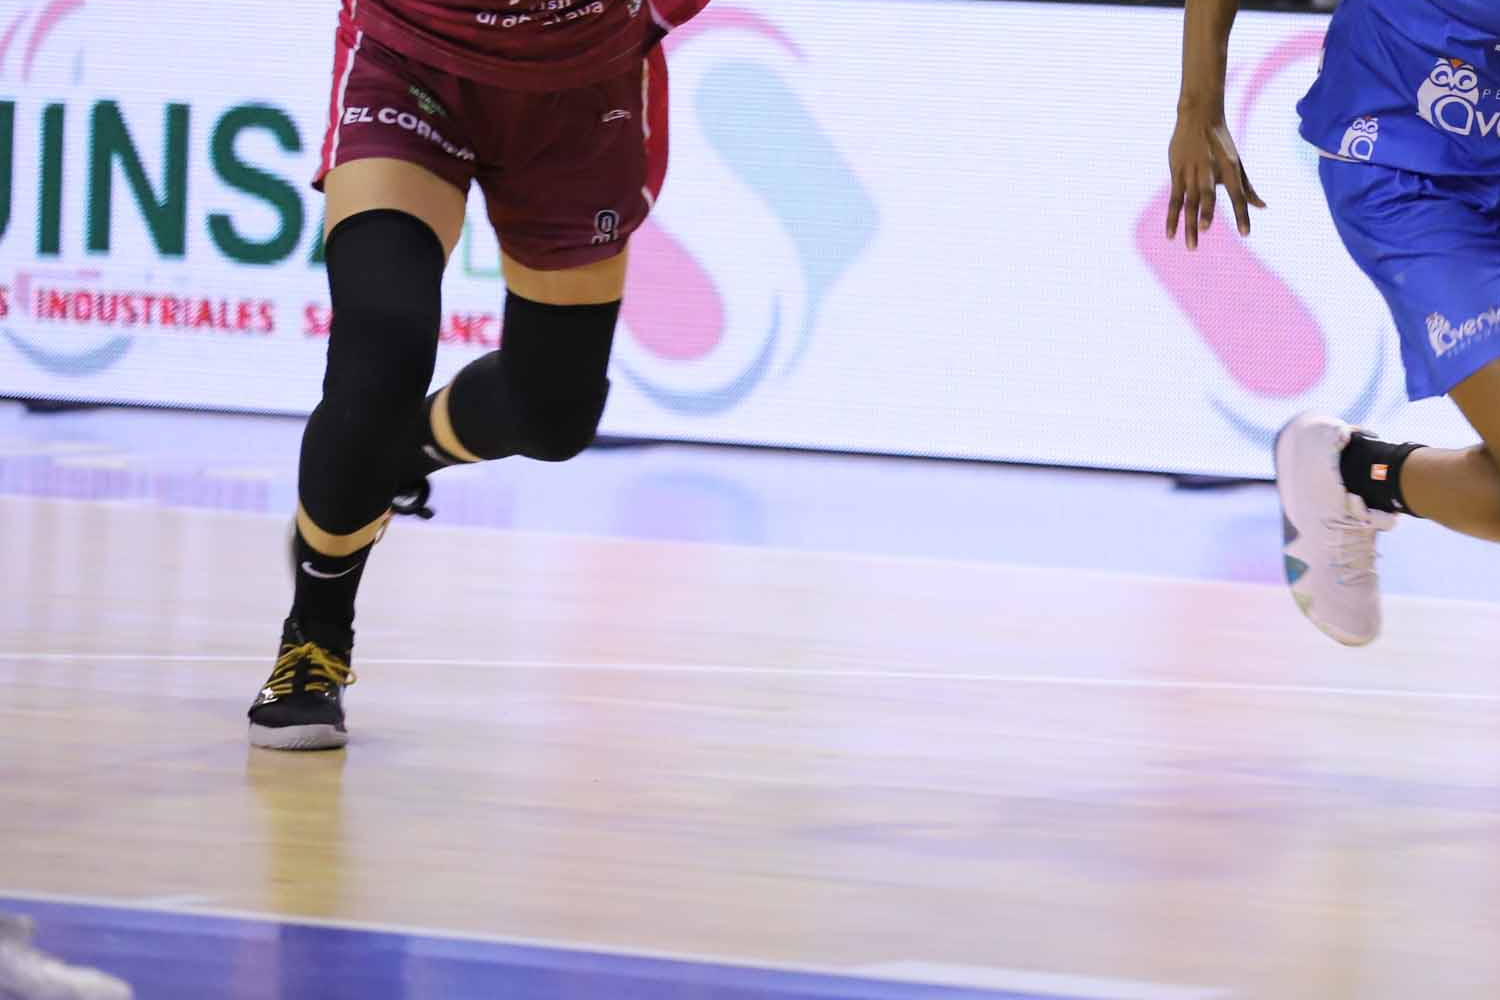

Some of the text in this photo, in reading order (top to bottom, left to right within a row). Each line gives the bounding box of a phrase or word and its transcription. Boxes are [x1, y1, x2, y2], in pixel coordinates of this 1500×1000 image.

[343, 107, 373, 125] EL
[0, 99, 326, 264] INS
[35, 287, 275, 334] INDUSTRIALES
